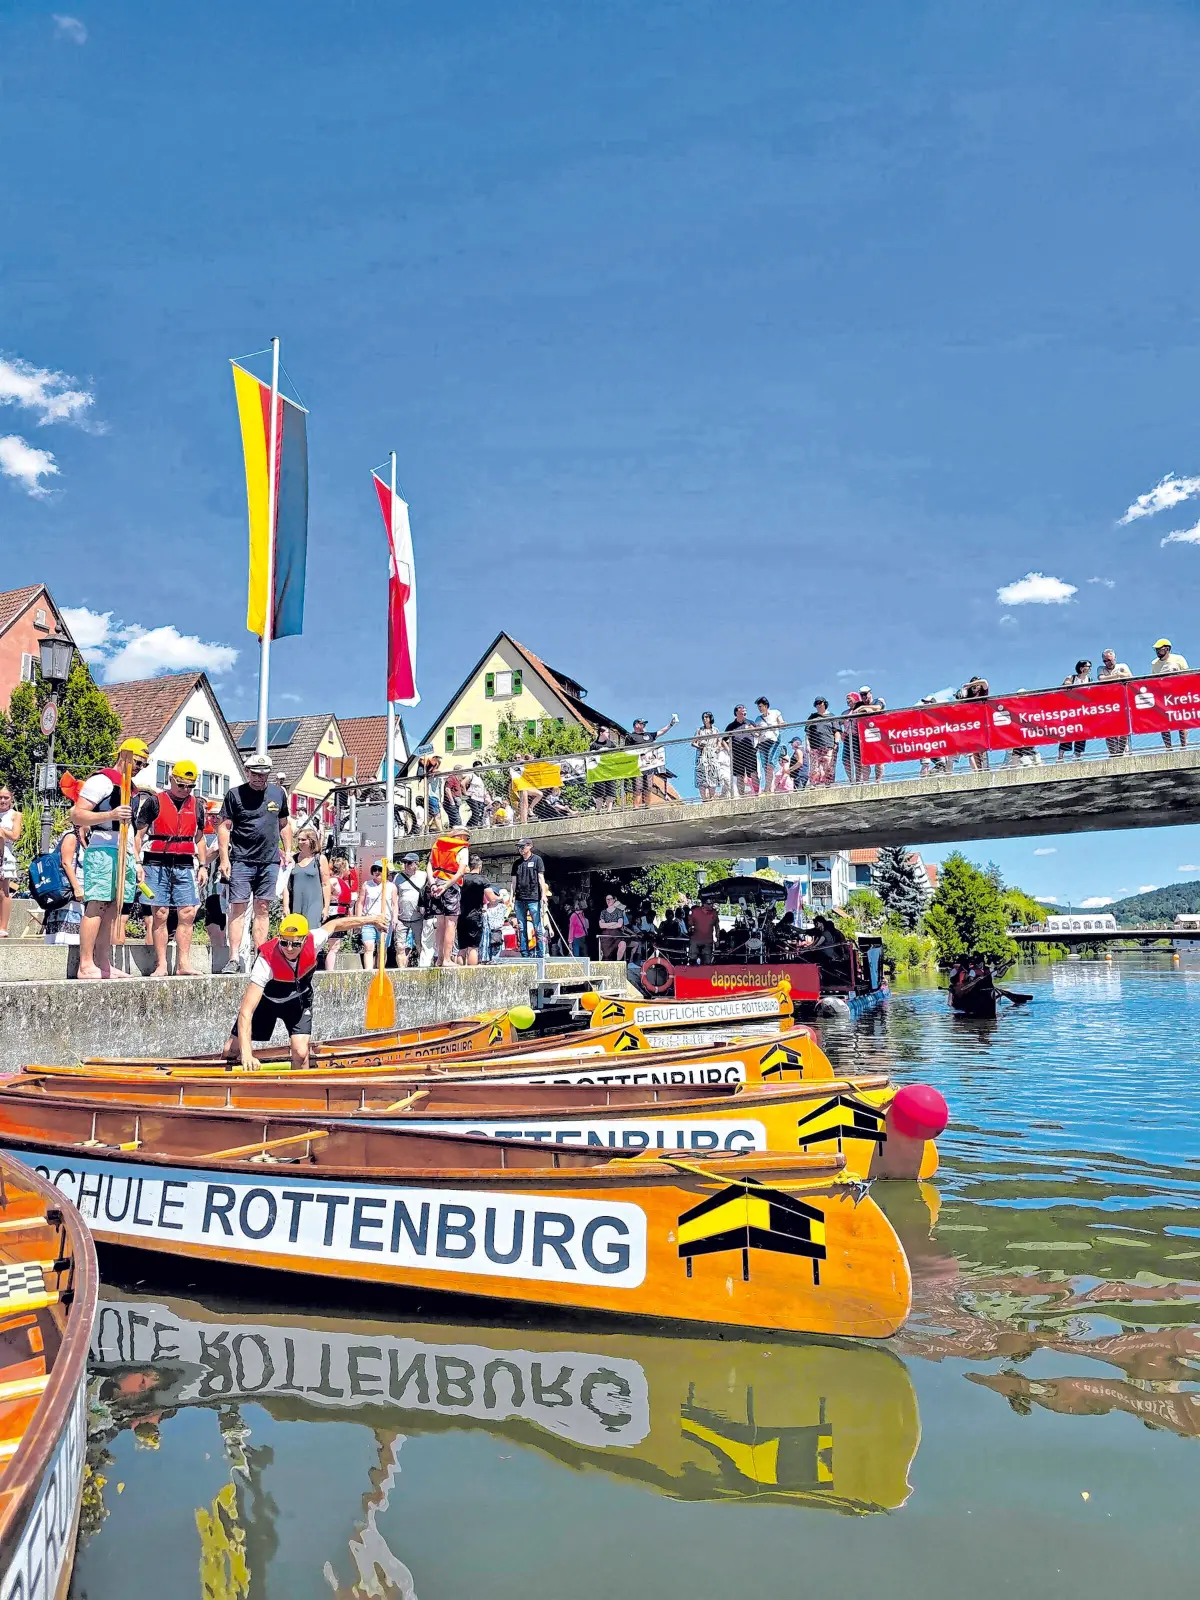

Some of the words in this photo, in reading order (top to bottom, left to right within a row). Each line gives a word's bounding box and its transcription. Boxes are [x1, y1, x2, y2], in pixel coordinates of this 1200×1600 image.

[1018, 703, 1121, 724] Kreissparkasse
[888, 720, 981, 739] Kreissparkasse
[1020, 723, 1083, 739] Tübingen
[890, 740, 947, 754] Tübingen
[636, 1007, 706, 1023] BERUFLICHE
[708, 1002, 741, 1017] SCHULE
[742, 1000, 779, 1014] ROTTENBURG
[553, 1067, 741, 1084] ENBURG
[201, 1184, 631, 1274] ROTTENBURG
